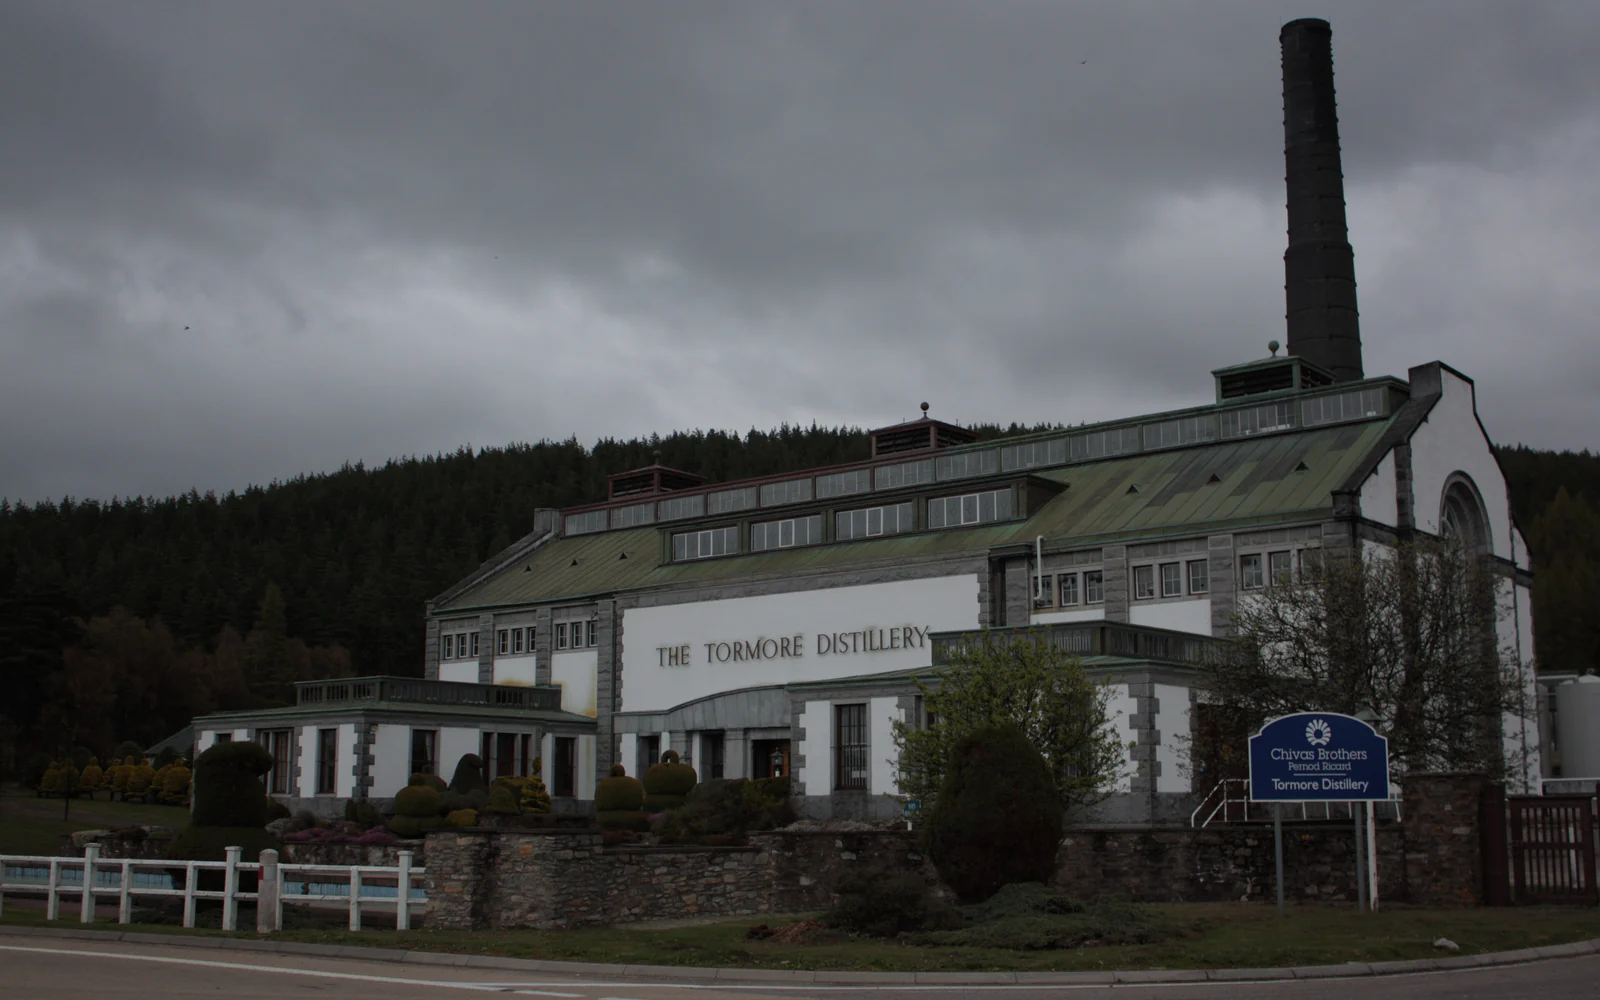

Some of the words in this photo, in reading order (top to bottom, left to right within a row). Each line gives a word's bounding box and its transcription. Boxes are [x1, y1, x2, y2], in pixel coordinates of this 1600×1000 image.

[656, 645, 690, 667] THE
[704, 635, 803, 664] TORMORE
[817, 625, 929, 655] DISTILLERY
[1270, 748, 1315, 760] Chivas
[1317, 748, 1368, 760] Brothers
[1288, 762, 1320, 771] Pernod
[1322, 762, 1352, 771] Ricard
[1271, 778, 1319, 790] Tormore
[1322, 778, 1369, 793] Distillery
